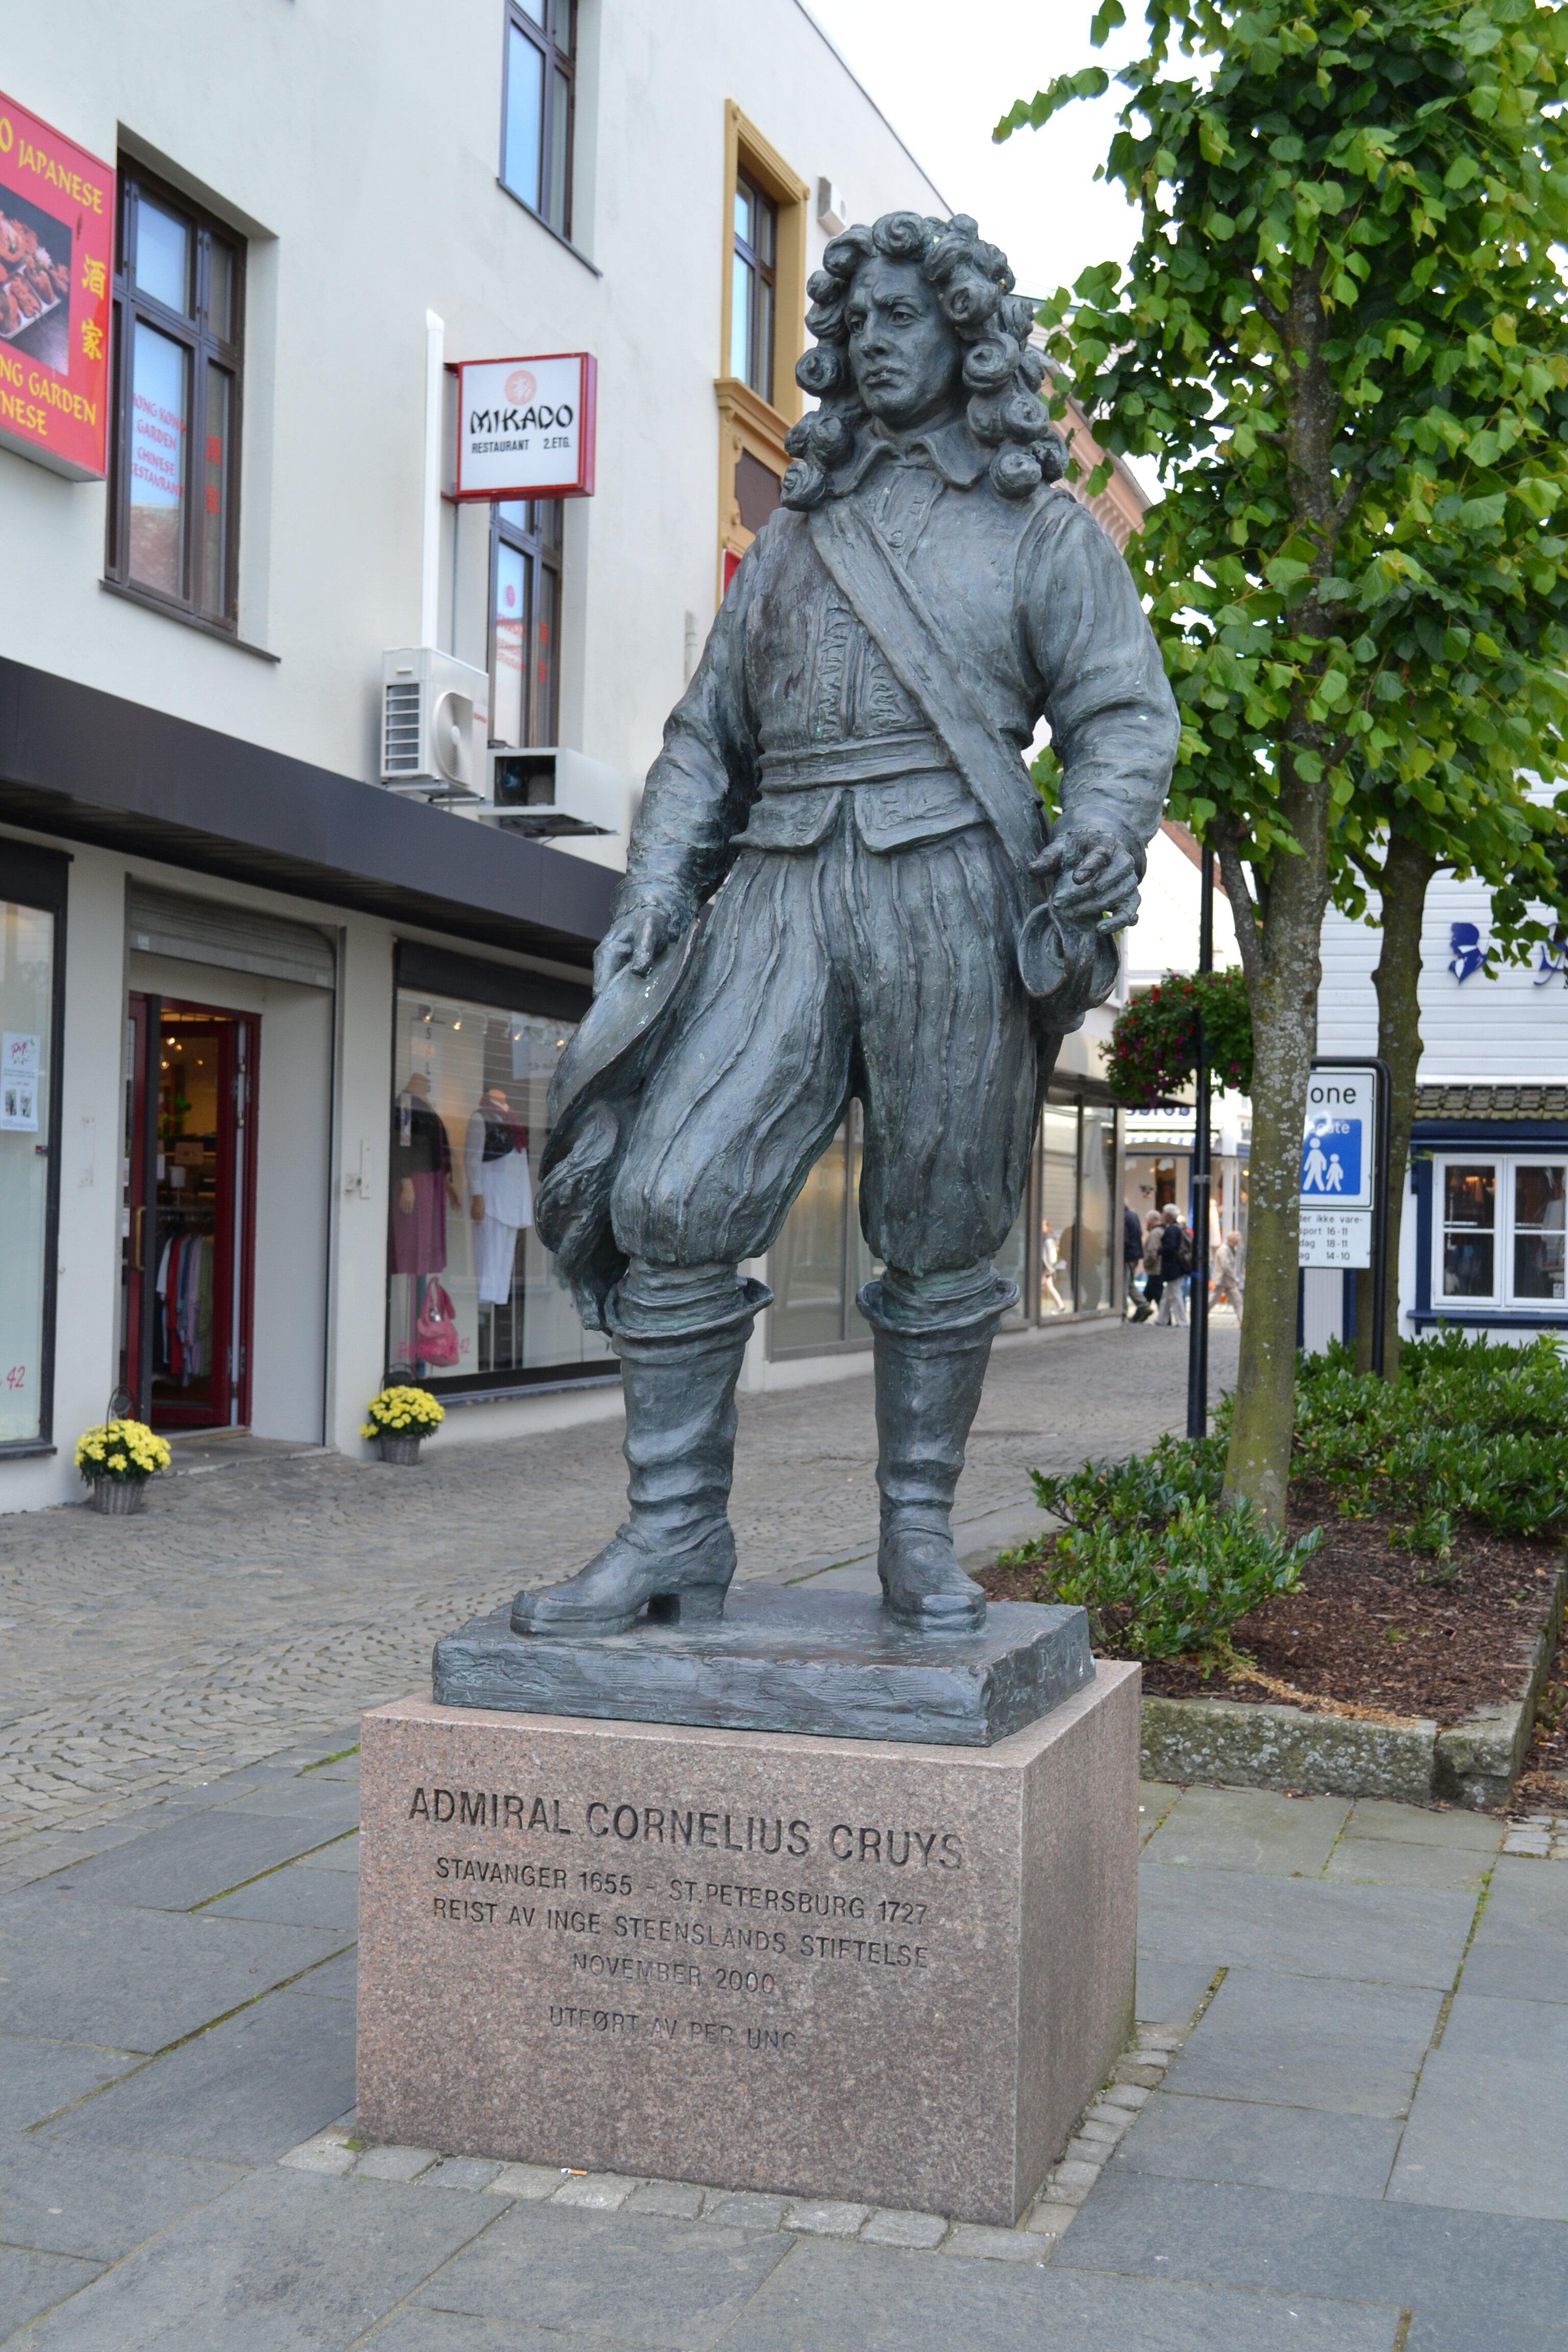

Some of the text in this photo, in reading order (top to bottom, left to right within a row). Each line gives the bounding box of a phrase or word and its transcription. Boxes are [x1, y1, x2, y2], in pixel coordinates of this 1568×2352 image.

[18, 139, 103, 214] JAPANESE
[28, 372, 96, 426] GARDEN
[137, 419, 177, 451] GARDEN
[470, 404, 573, 434] MIKADO
[137, 446, 176, 476] CHINESE
[472, 439, 530, 454] RESTAURANT
[1311, 1087, 1356, 1104] one
[1316, 1215, 1335, 1223] ikke
[6, 1365, 26, 1390] 42
[409, 1788, 962, 1870] ADMIRAL CORNELIUS CRUYS
[436, 1857, 567, 1890] STAVANGER
[579, 1871, 632, 1896] 1655
[878, 1901, 927, 1925] 1727
[433, 1898, 928, 1968] REIST AV INGE STEENSLANDS STIFTELSE
[574, 1953, 775, 1994] NOVEMBER 2000
[549, 2006, 639, 2033] UTFØRT
[652, 2018, 677, 2040] AV
[690, 2021, 733, 2043] PER
